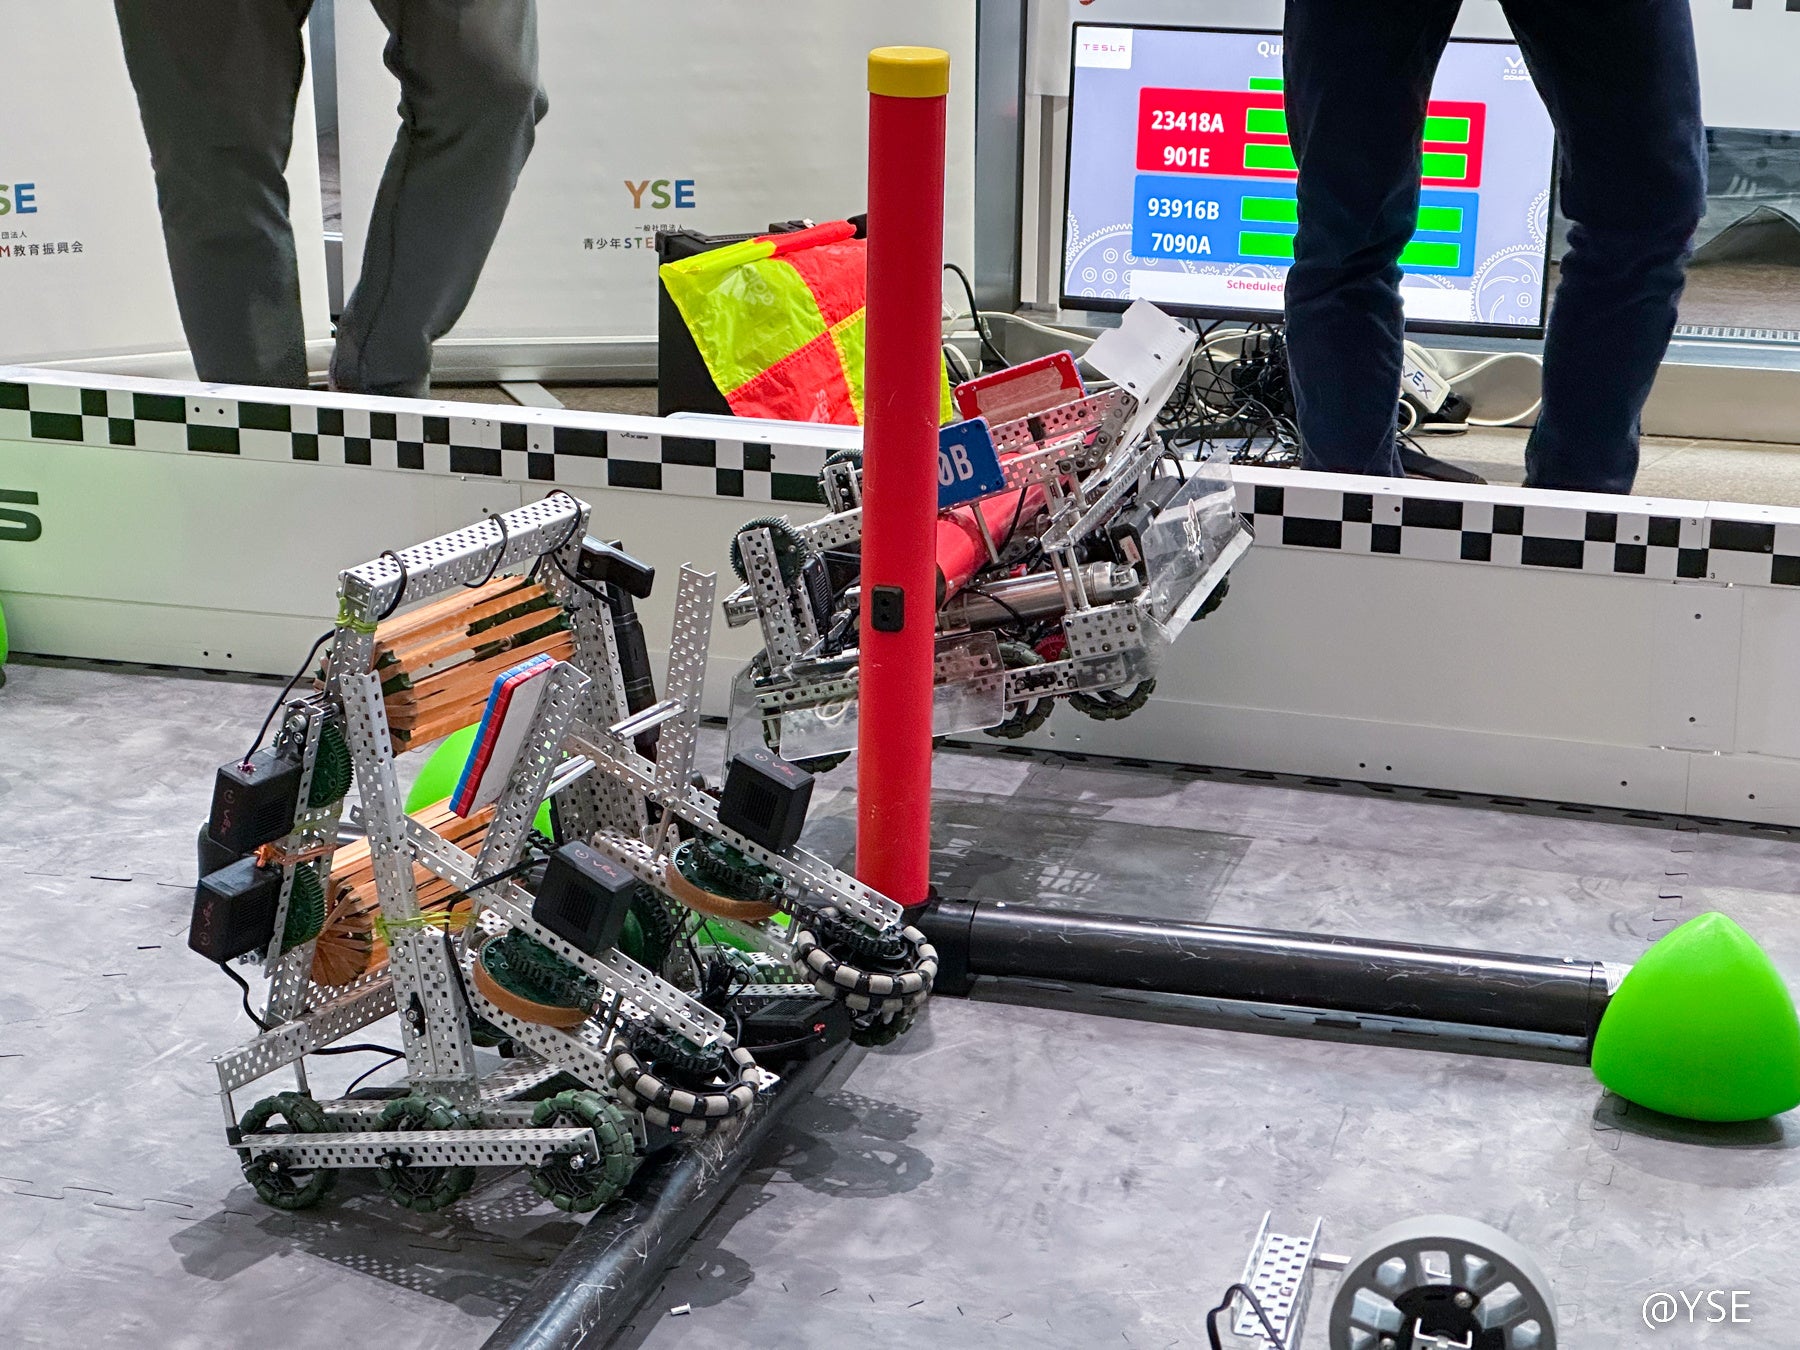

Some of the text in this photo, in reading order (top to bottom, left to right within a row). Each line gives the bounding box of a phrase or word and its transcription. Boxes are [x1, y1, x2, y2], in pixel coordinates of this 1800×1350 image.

[1083, 43, 1126, 52] TESLA
[1151, 110, 1225, 133] 23418A
[1163, 146, 1210, 167] 901E
[0, 183, 38, 215] SE
[624, 179, 696, 209] YSE
[1148, 197, 1220, 220] 93916B
[0, 240, 84, 257] M教育振興会
[583, 237, 655, 249] 青少年STE
[1151, 232, 1212, 255] 7090A
[1226, 279, 1284, 292] Scheduled
[938, 444, 974, 486] 0B
